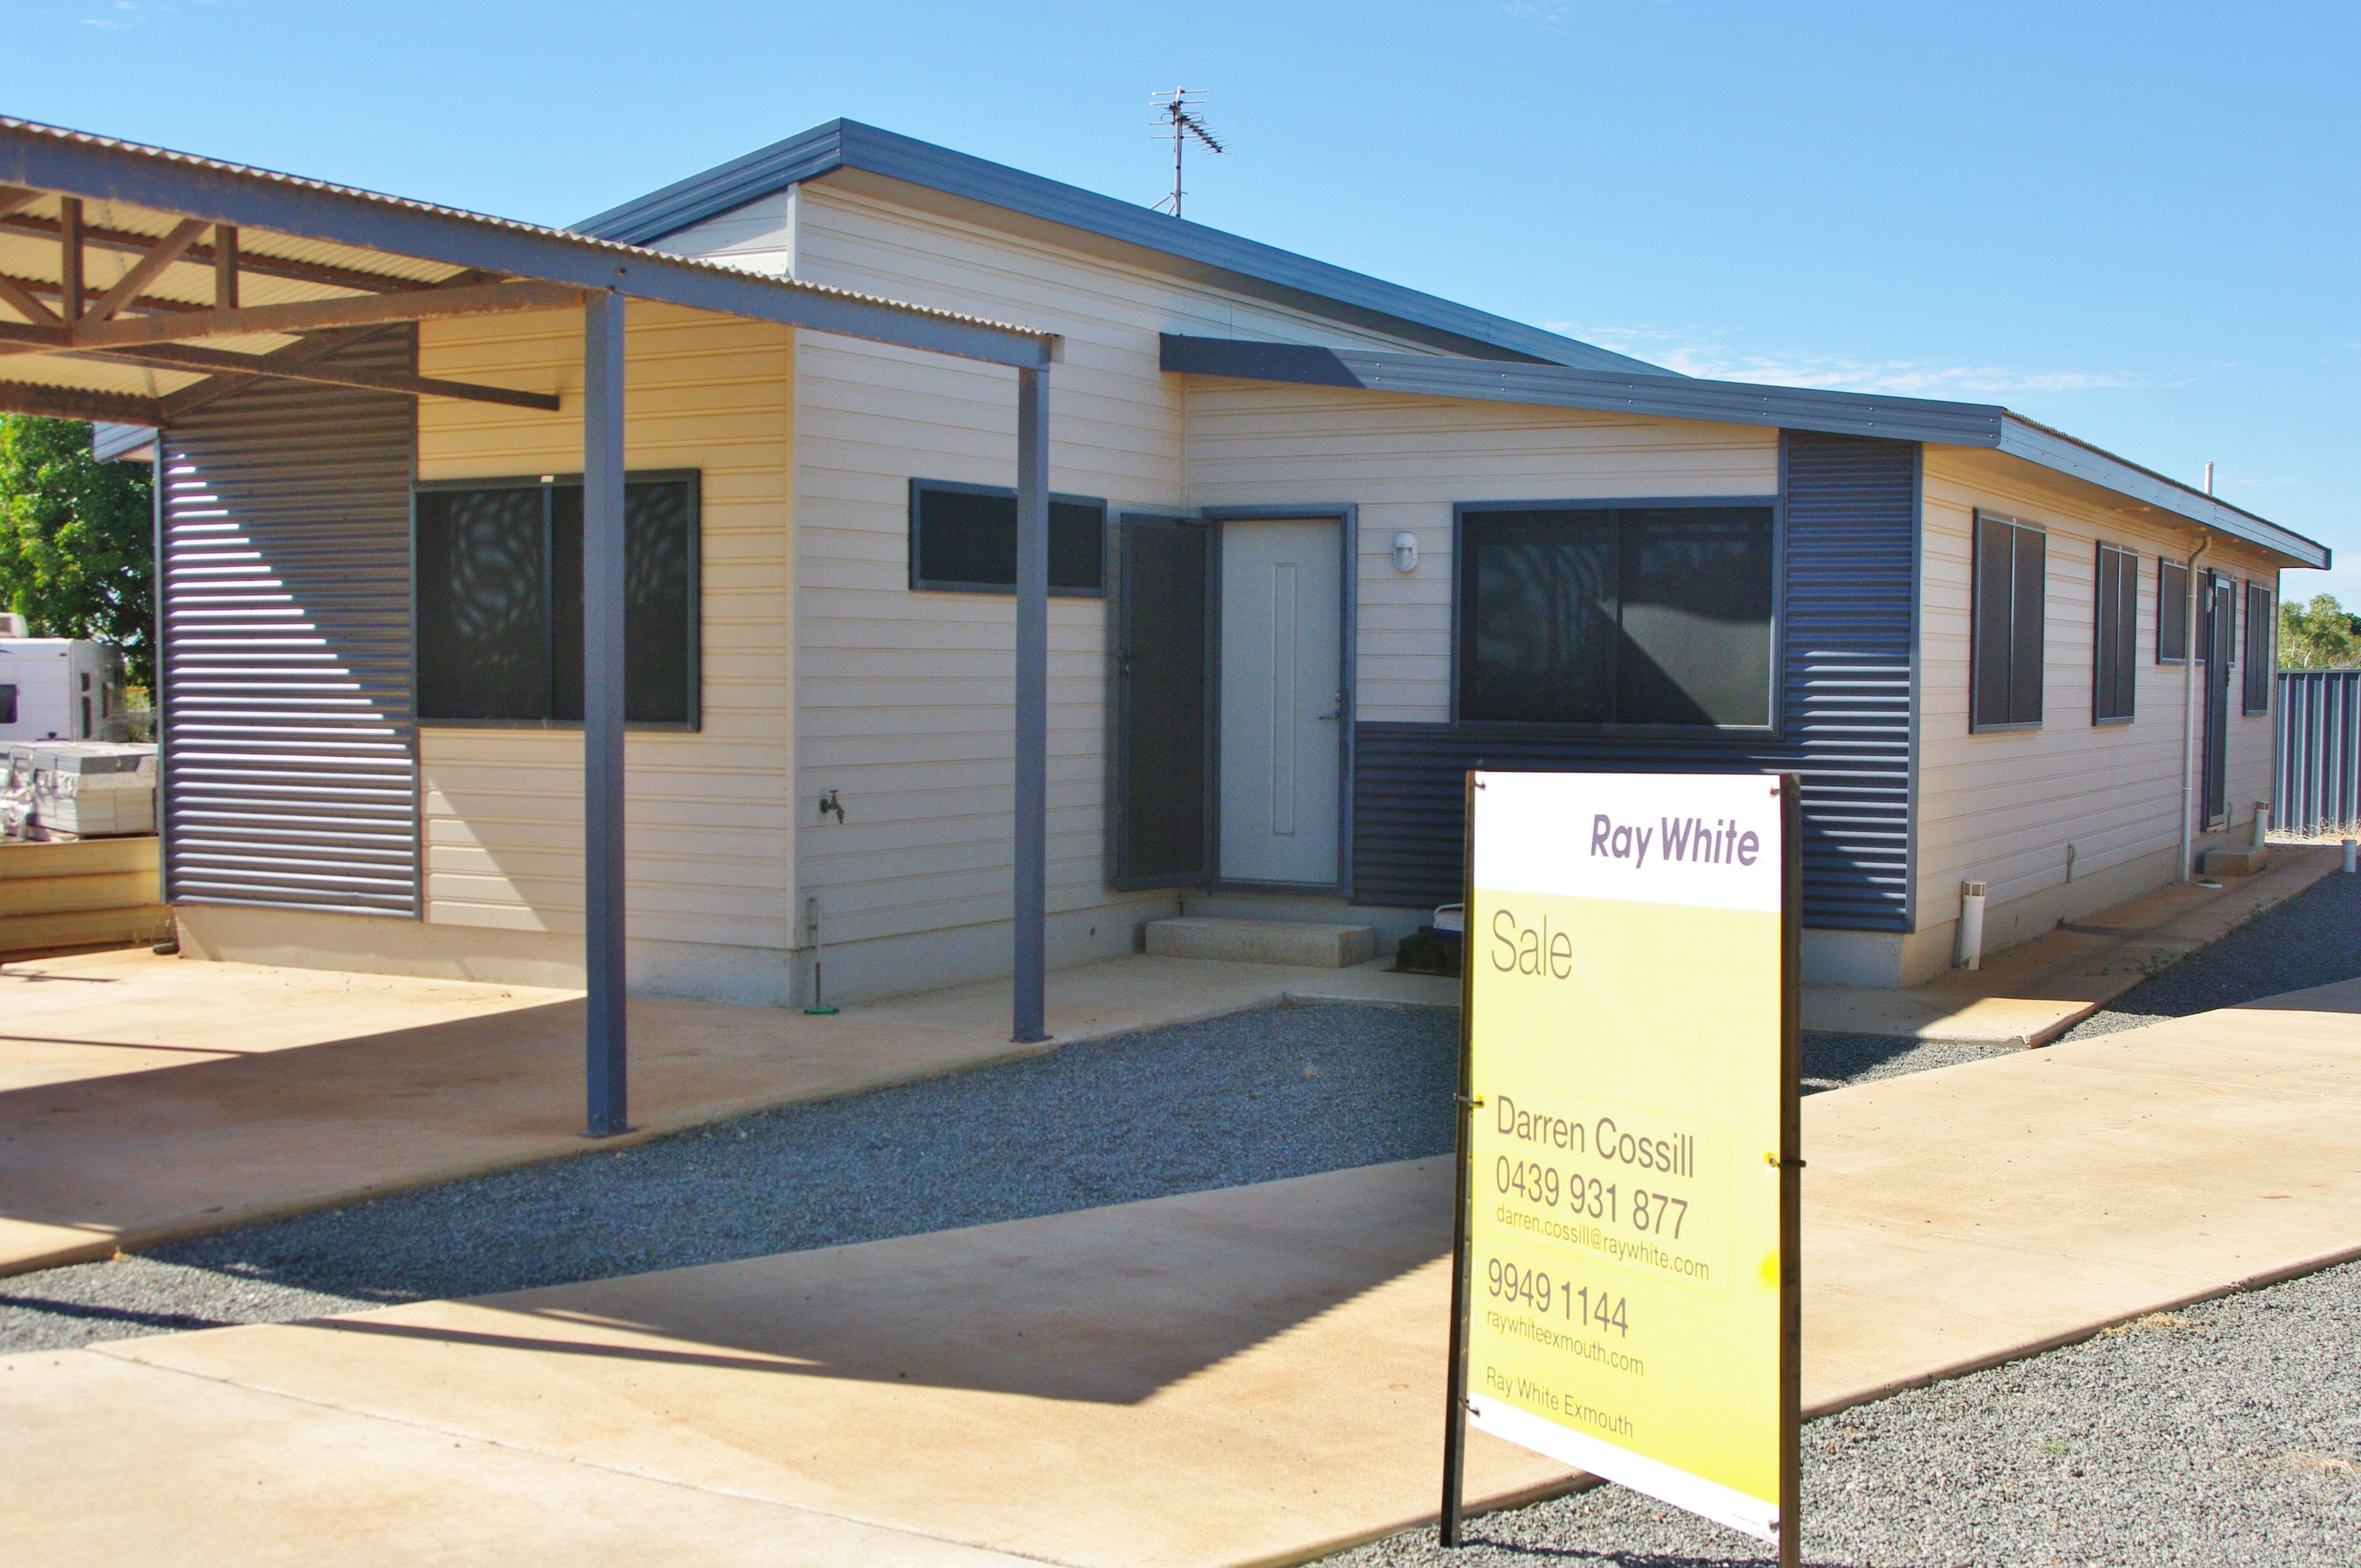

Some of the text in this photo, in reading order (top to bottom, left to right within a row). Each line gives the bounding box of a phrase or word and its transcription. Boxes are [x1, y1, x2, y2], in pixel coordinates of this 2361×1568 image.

[1591, 814, 1759, 869] Ray White
[1491, 910, 1572, 979] Sale
[1497, 1095, 1694, 1178] Darren Cossill
[1497, 1156, 1688, 1240] 0439 931 877
[1497, 1204, 1709, 1281] darren.cossill@raywhite.com
[1488, 1258, 1629, 1338] 9949 1144
[1487, 1309, 1644, 1376] raywhiteexmouth.com
[1487, 1366, 1634, 1439] Ray White Exmouth
